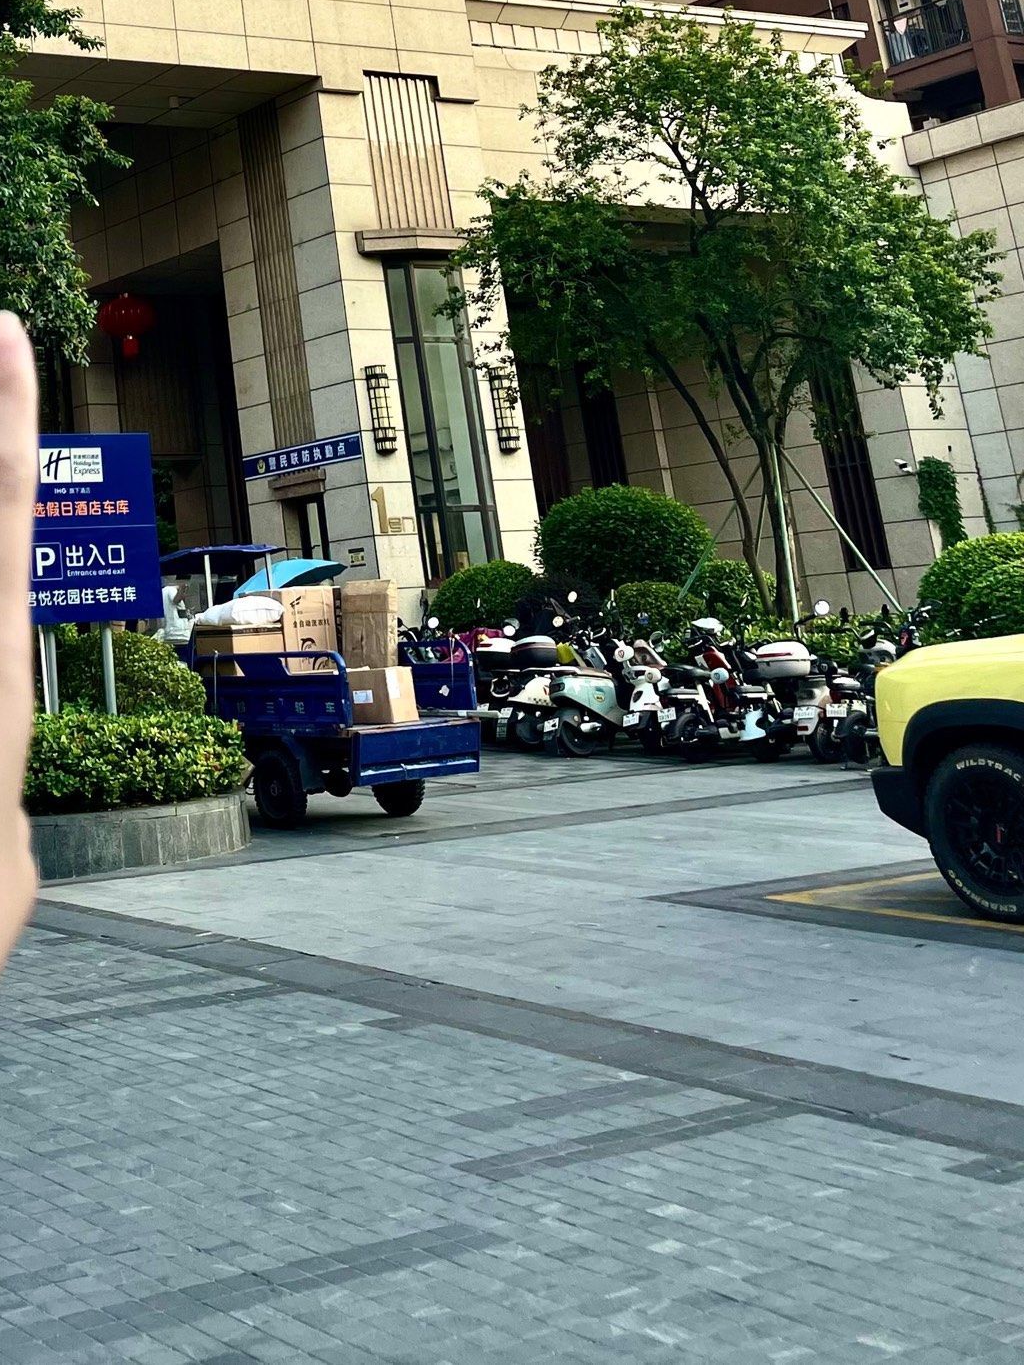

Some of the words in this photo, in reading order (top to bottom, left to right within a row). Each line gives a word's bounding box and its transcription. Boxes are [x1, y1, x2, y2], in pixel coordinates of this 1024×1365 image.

[268, 442, 346, 470] 警民联防执勤点
[73, 466, 101, 476] Express
[33, 500, 130, 517] 选假日酒店车库
[35, 547, 56, 577] P
[65, 543, 125, 567] 出入口
[67, 569, 97, 577] Entrance
[27, 586, 137, 607] 君悦花园住宅车库
[956, 758, 1022, 782] WILDTRAC
